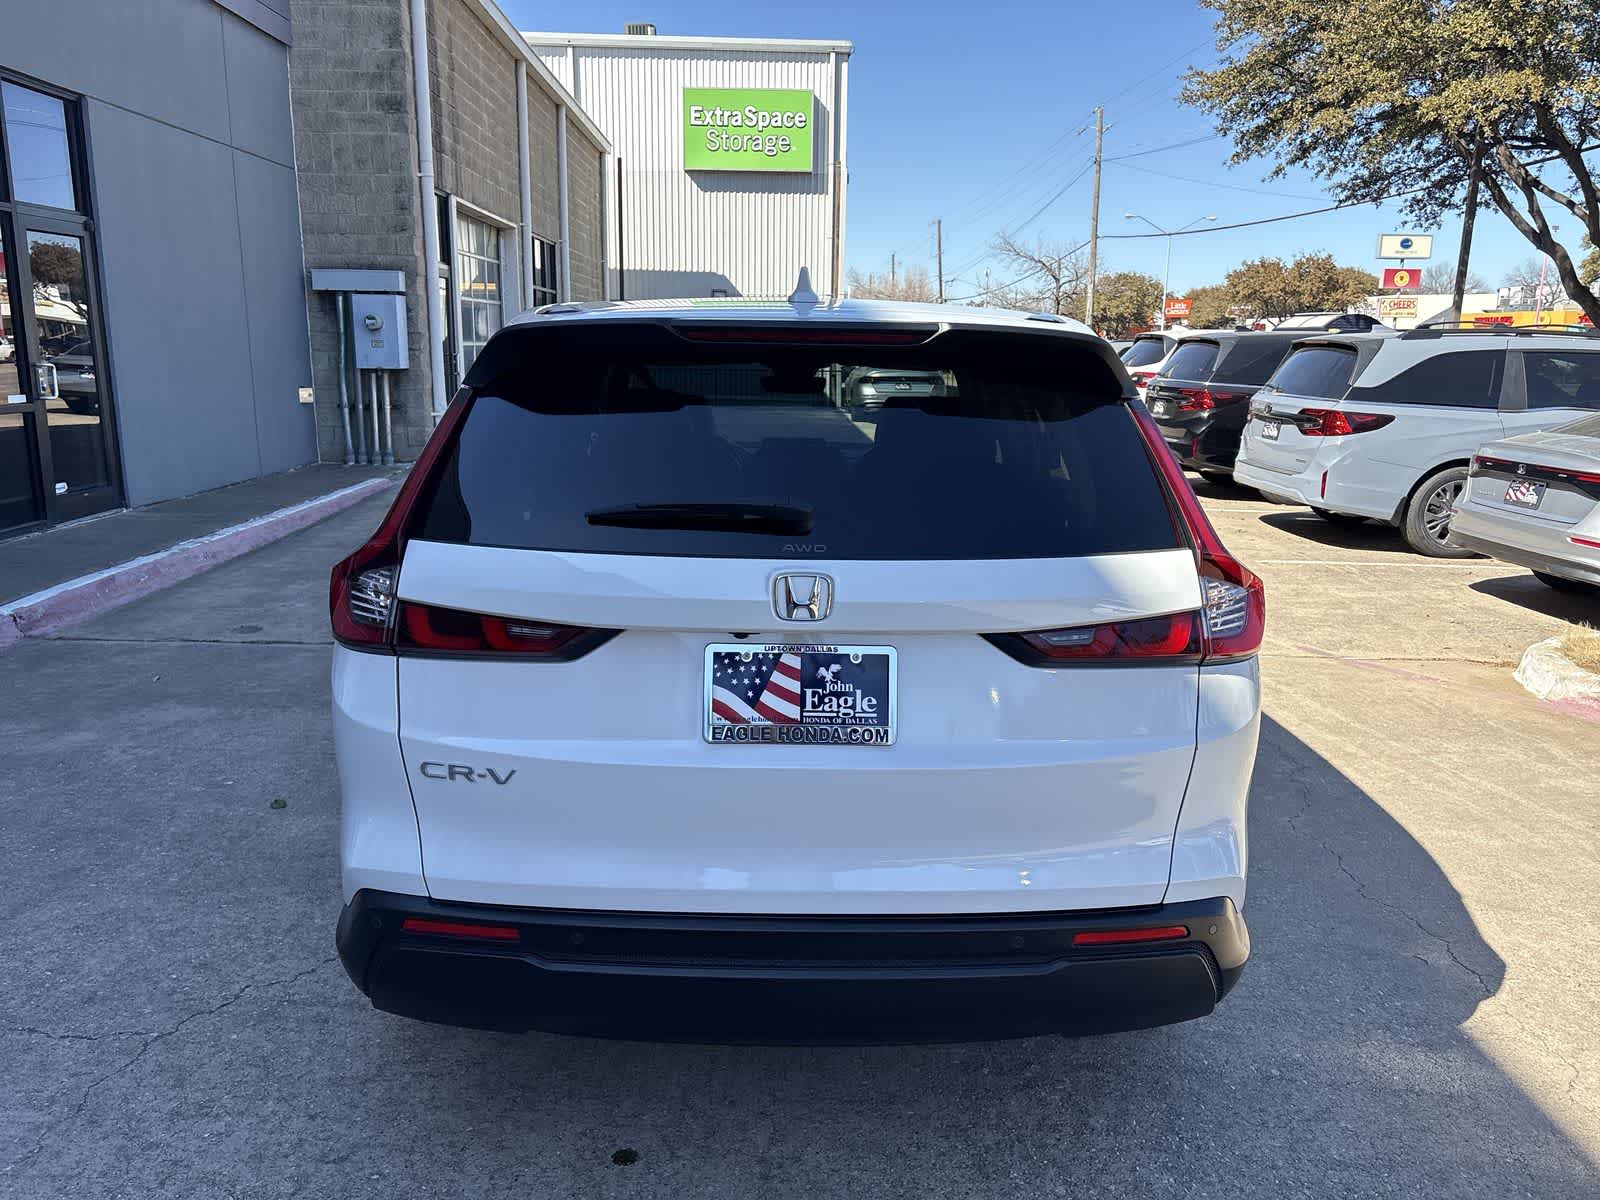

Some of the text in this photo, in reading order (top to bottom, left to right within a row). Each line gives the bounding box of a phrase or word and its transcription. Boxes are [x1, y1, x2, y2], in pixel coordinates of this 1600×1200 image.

[705, 128, 791, 157] Storage
[1389, 300, 1416, 309] CHEERS
[783, 544, 826, 552] AWD
[803, 688, 877, 717] Eagle
[711, 726, 890, 744] EAGLE HONDA.COM
[420, 762, 517, 784] CR-V
